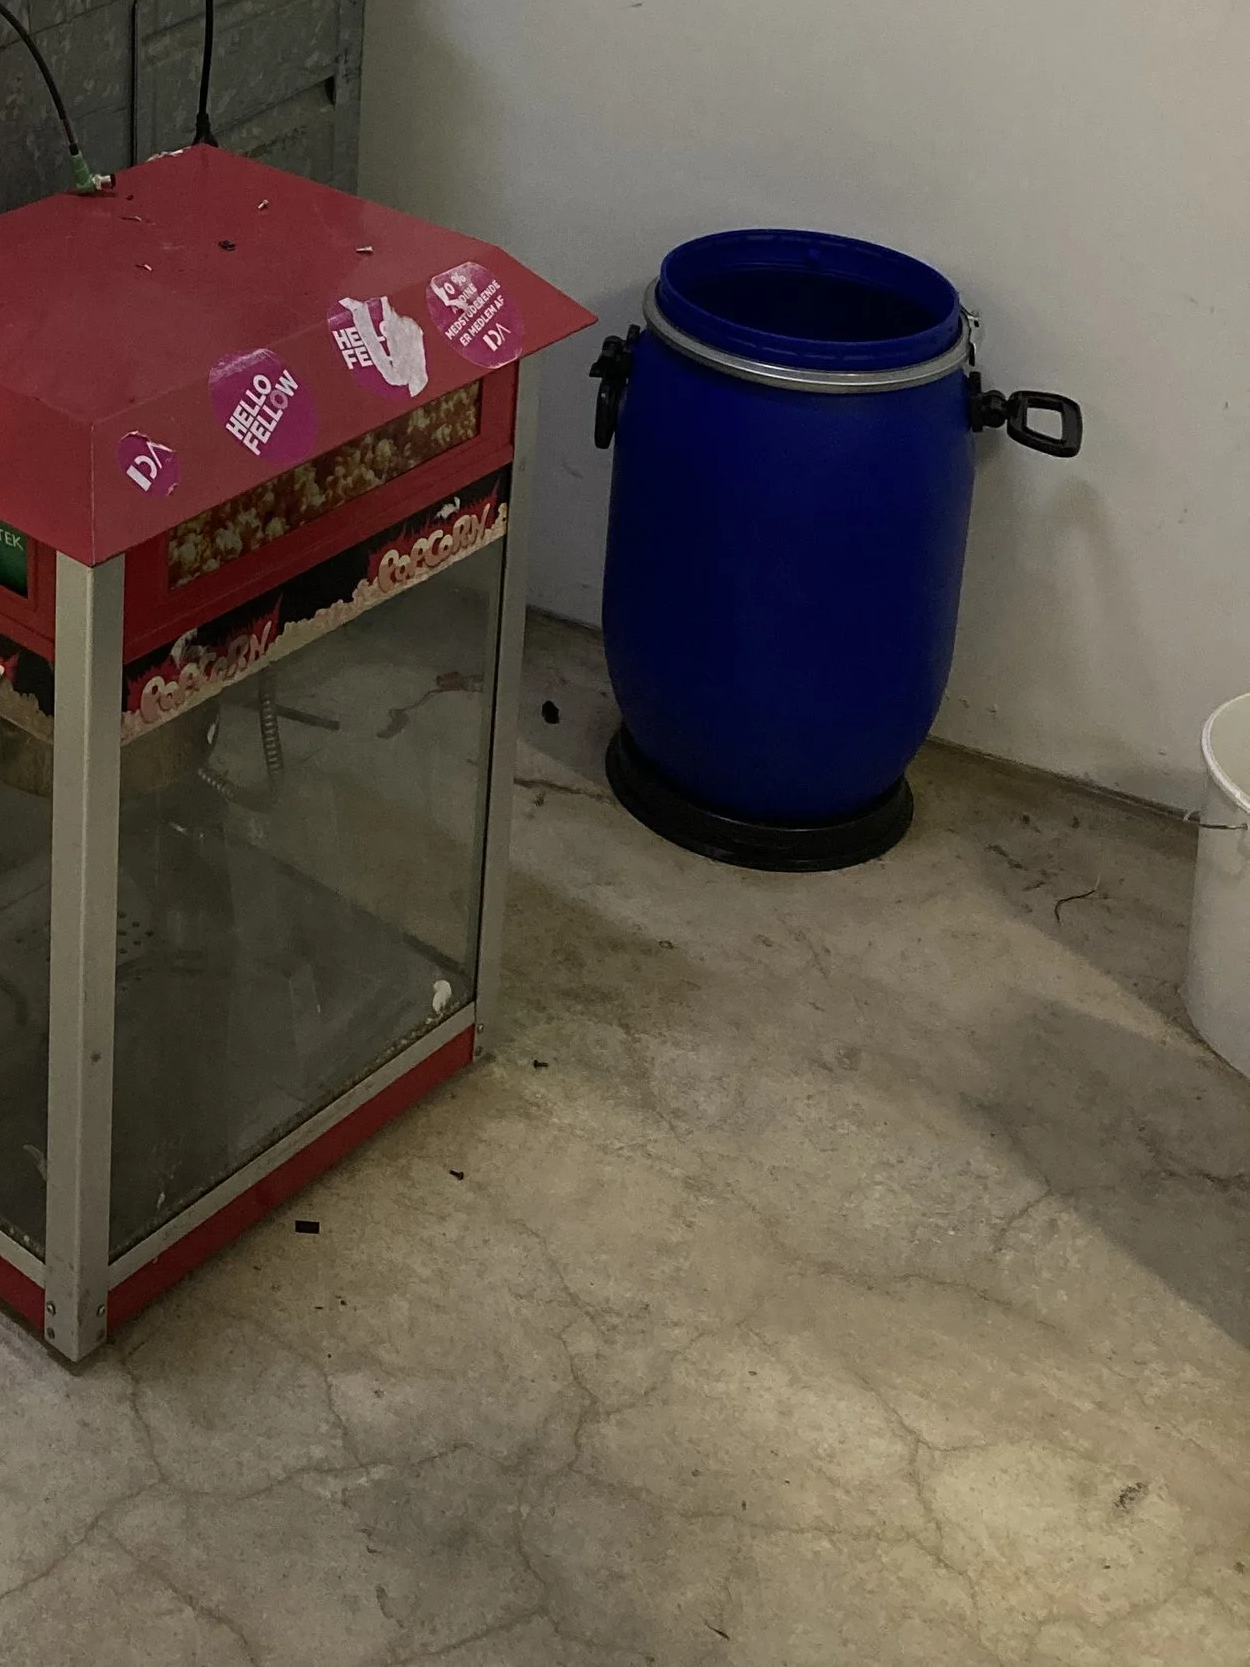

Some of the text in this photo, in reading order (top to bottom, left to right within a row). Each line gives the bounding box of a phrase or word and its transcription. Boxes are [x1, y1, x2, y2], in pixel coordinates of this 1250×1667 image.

[445, 279, 501, 340] MEDSTUDERENDE
[459, 294, 505, 347] ER MEDLEM AF
[225, 374, 272, 441] HELLO
[242, 369, 298, 456] FELLOW
